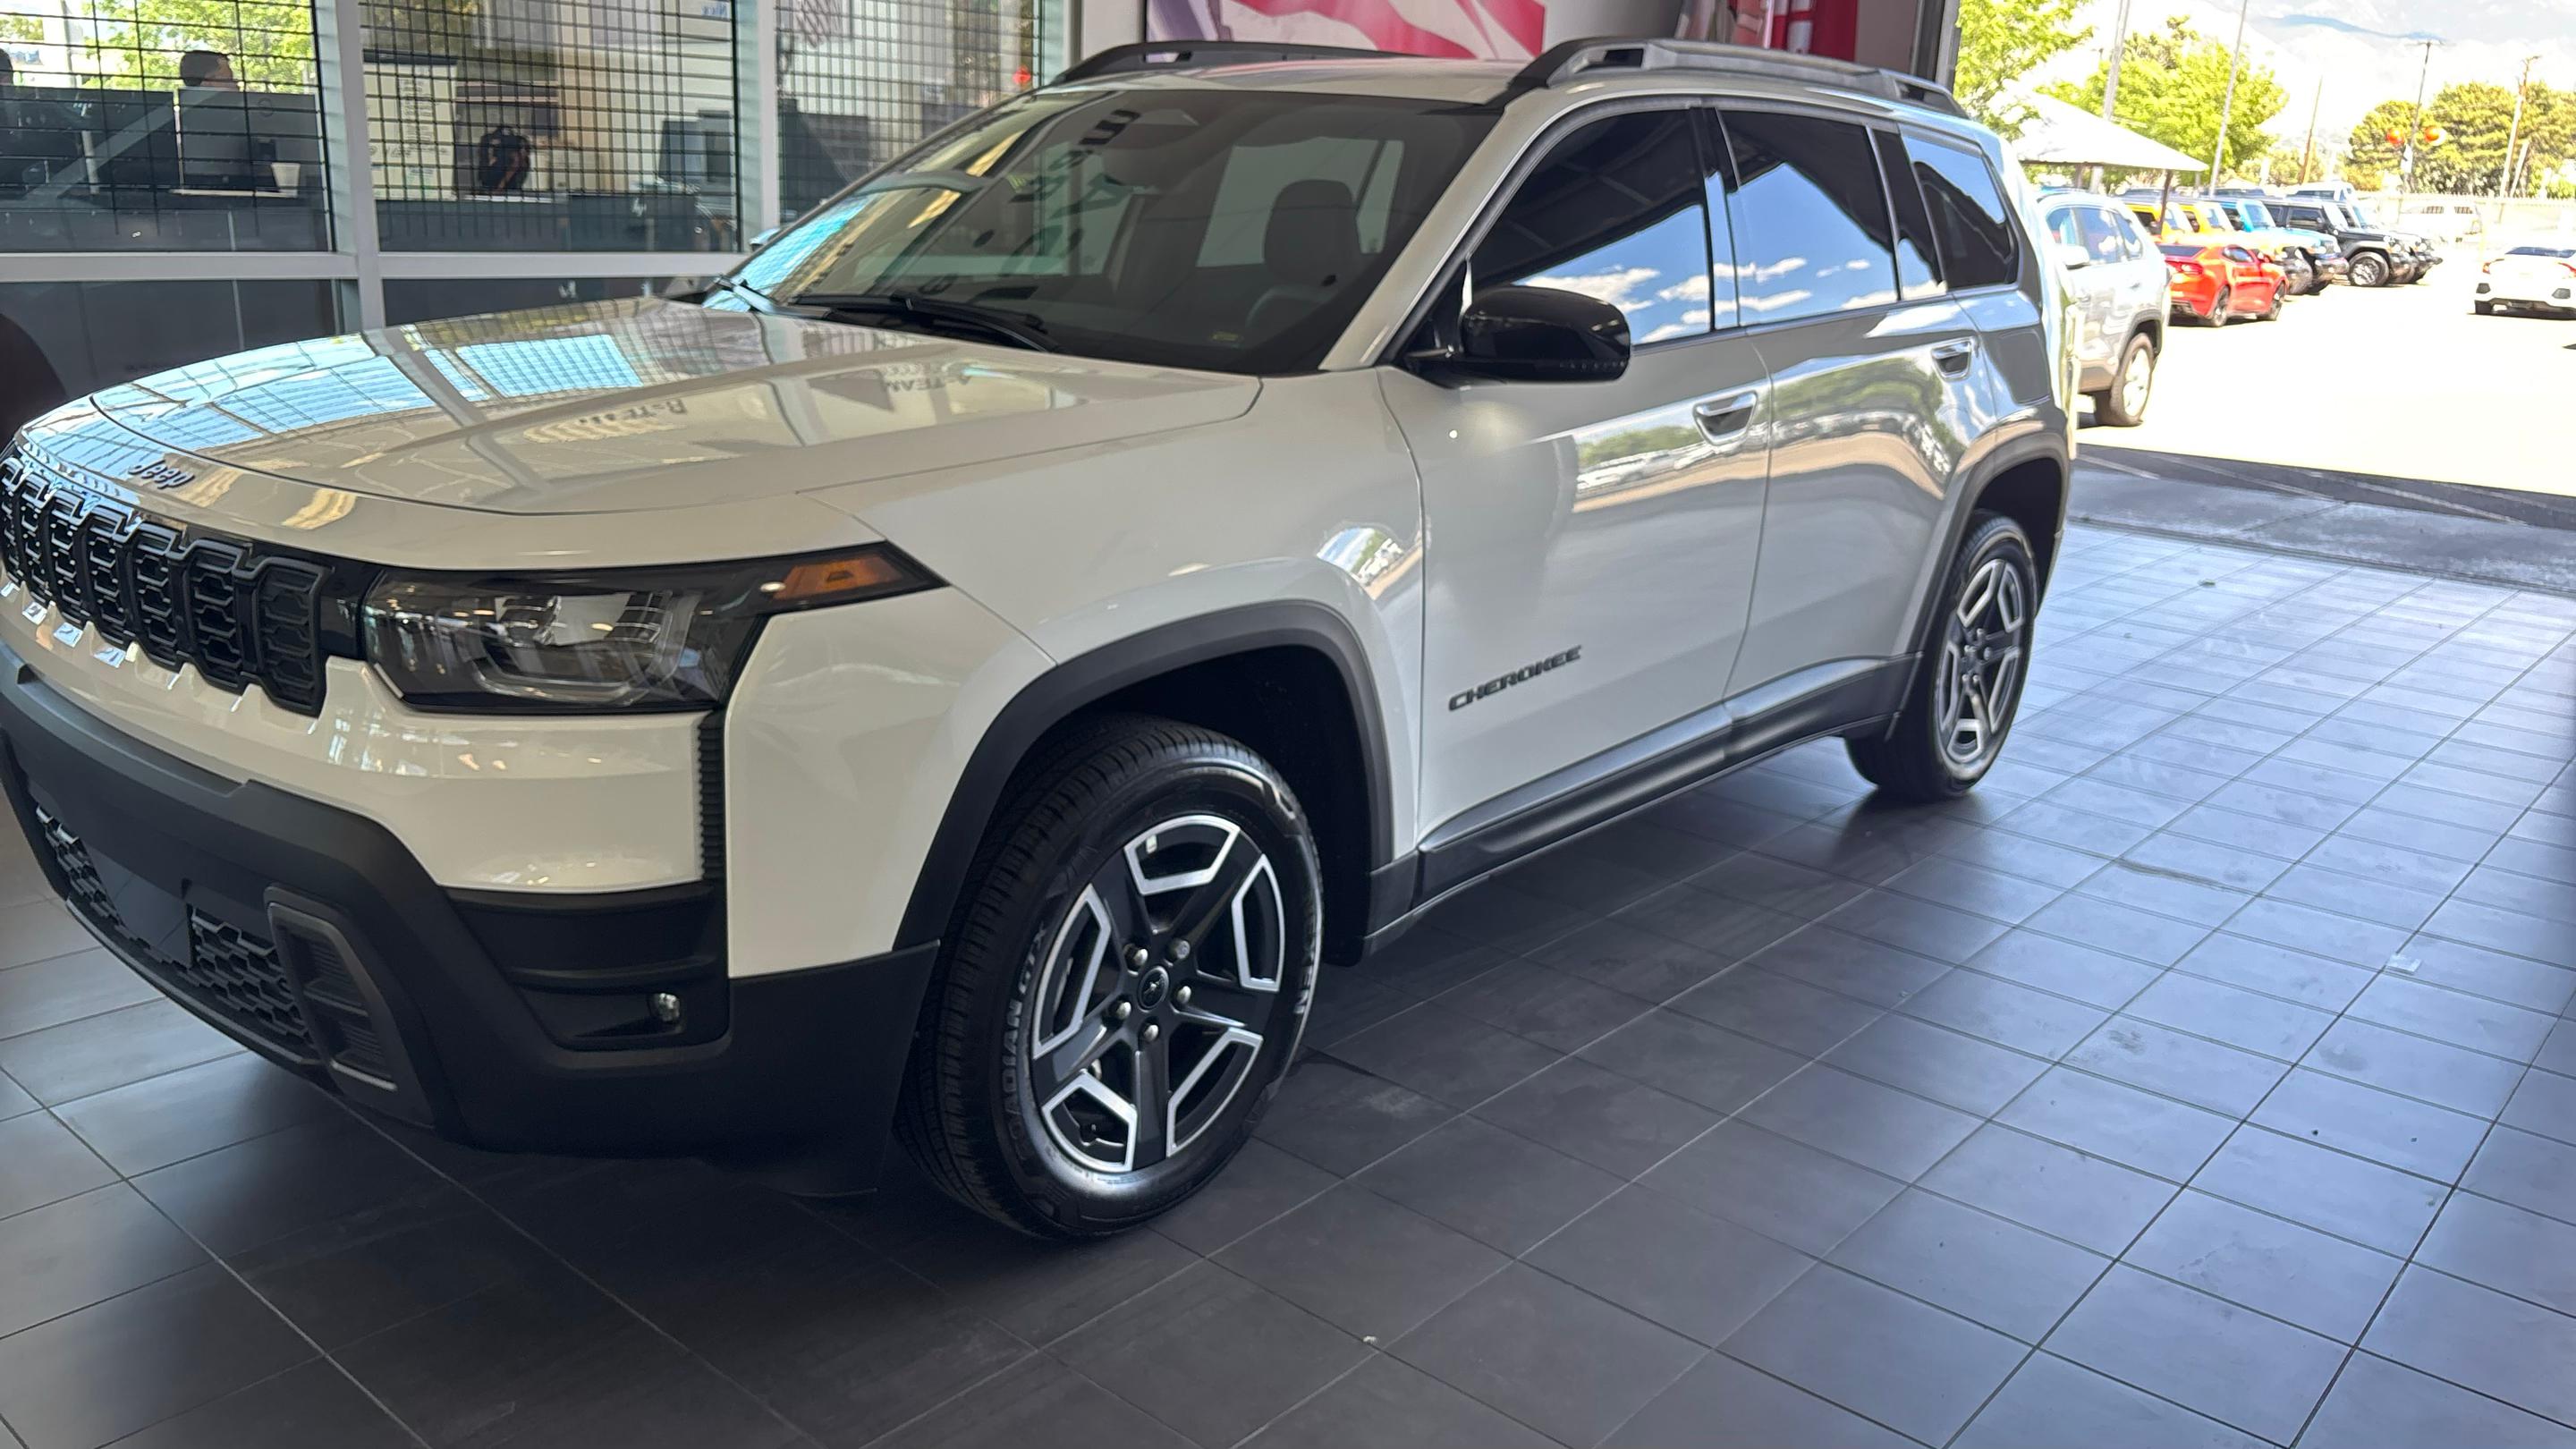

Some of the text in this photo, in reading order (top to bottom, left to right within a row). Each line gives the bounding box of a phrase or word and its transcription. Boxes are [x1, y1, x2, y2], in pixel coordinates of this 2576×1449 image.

[128, 459, 196, 489] Jeep
[1448, 644, 1582, 712] CHEROKEE
[1017, 920, 1046, 995] GTX
